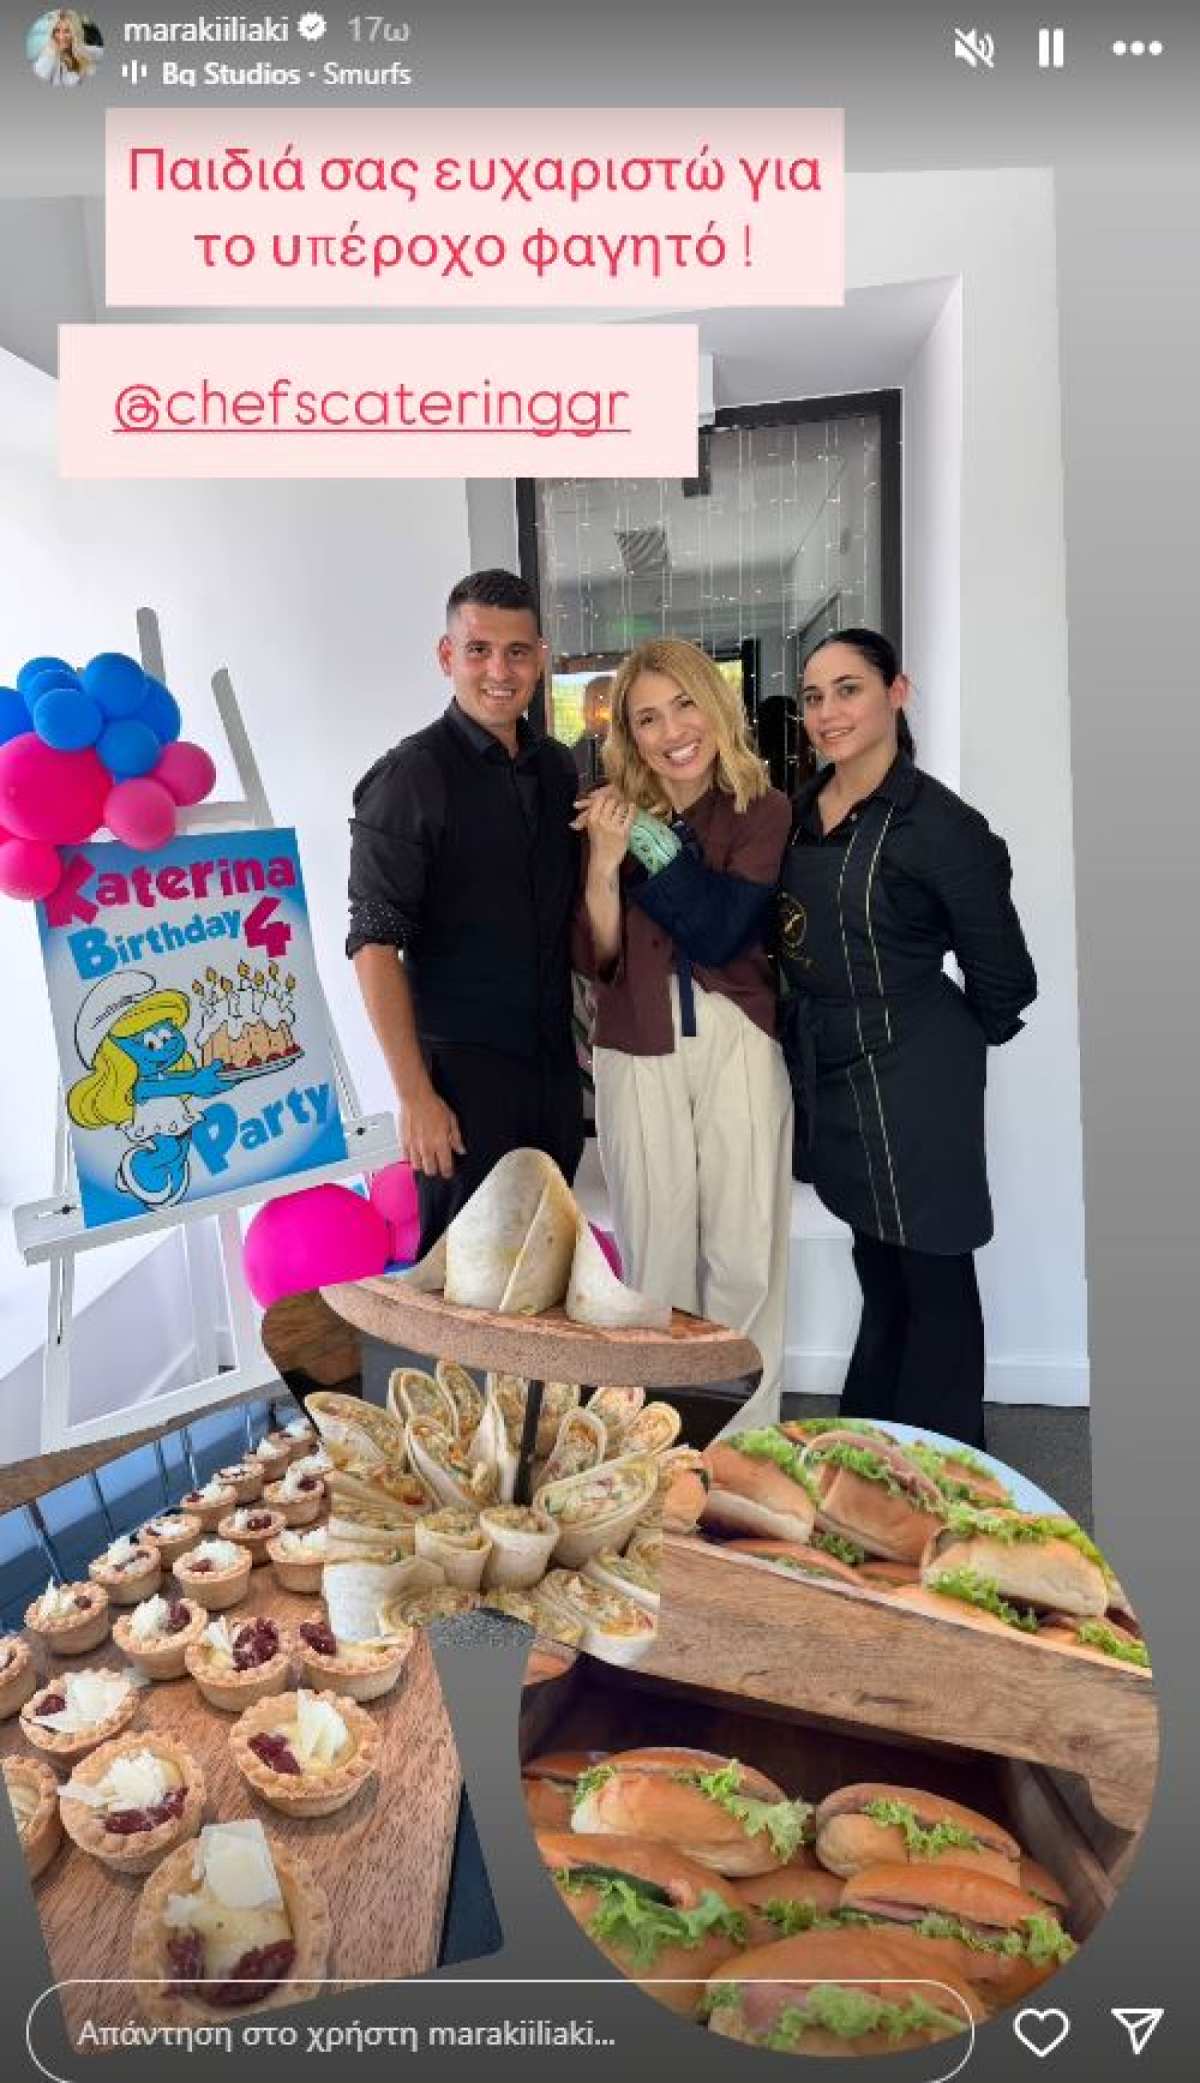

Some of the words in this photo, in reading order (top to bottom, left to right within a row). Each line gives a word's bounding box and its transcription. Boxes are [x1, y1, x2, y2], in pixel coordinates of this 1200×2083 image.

[45, 854, 296, 928] Katerina
[67, 910, 242, 980] Birthday
[244, 896, 292, 957] 4
[191, 1083, 330, 1176] Party
